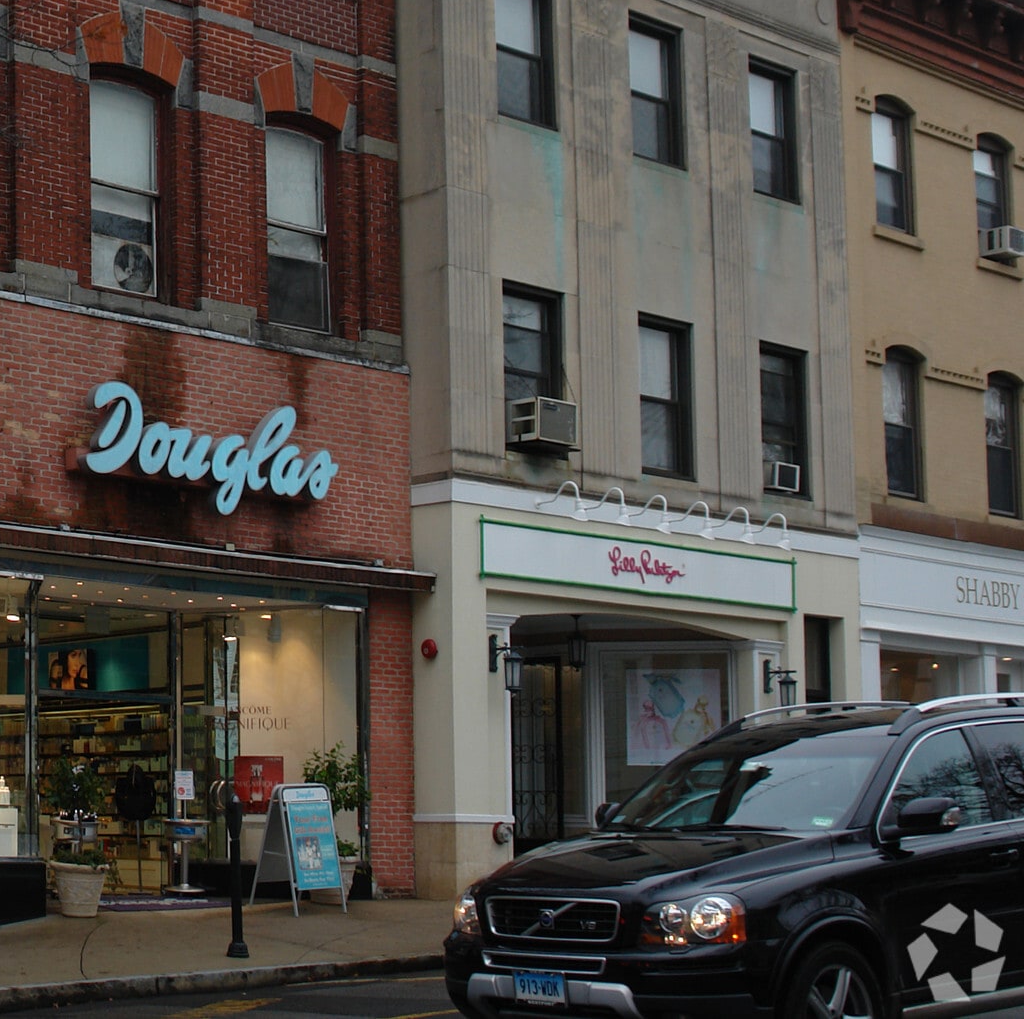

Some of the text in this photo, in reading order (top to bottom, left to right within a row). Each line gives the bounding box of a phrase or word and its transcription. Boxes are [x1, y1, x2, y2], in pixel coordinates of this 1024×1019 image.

[86, 381, 339, 515] Douglas
[608, 546, 645, 584] Lilly
[956, 575, 1020, 610] SHABBY
[519, 978, 560, 998] 913-WDK
